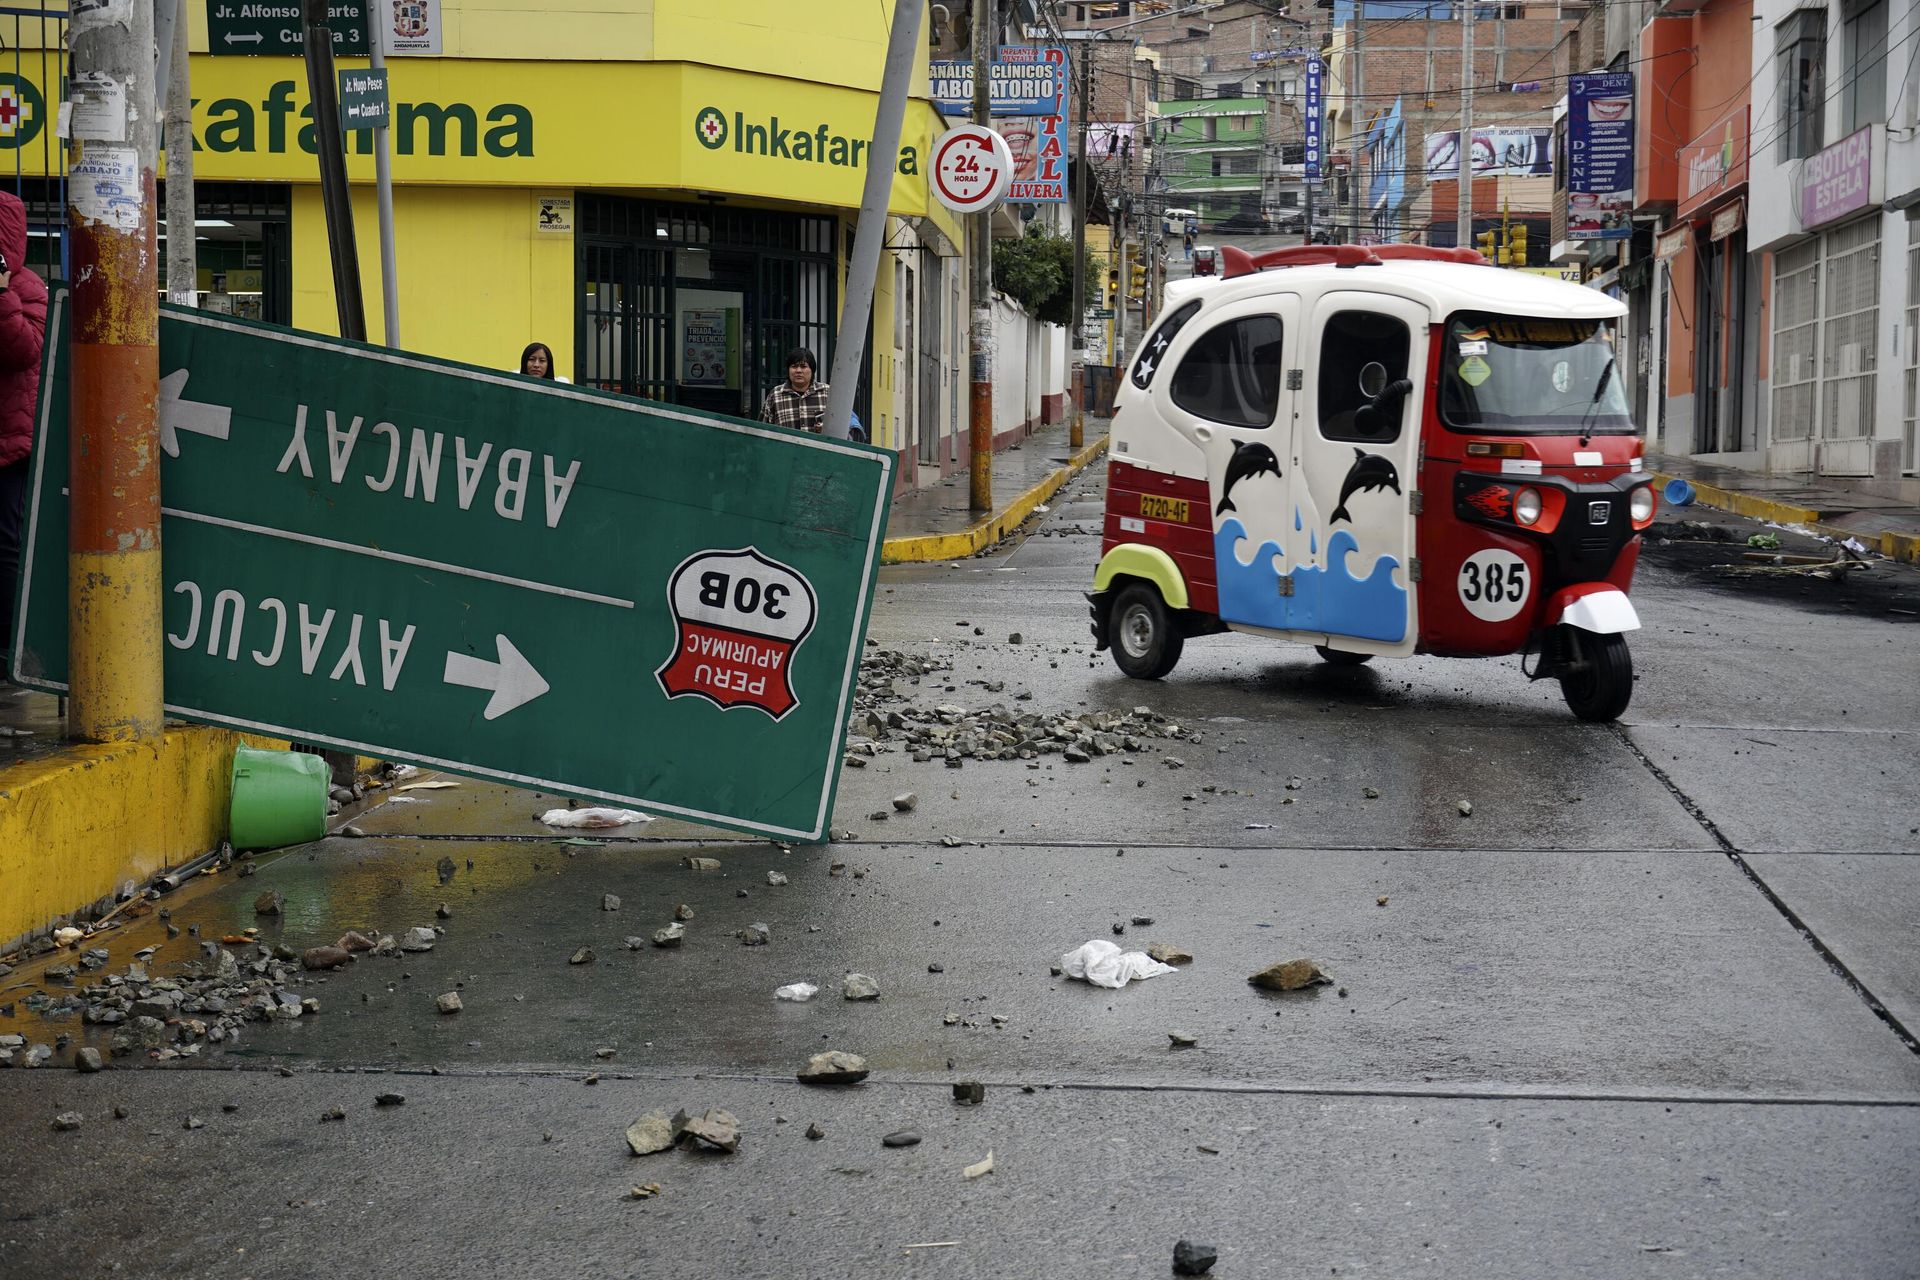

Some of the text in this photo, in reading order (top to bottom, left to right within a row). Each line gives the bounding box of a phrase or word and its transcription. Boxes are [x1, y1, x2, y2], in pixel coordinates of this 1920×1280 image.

[215, 5, 359, 18] Jr. Alfonso arte
[349, 28, 360, 43] 3
[929, 62, 1053, 79] ANÁLIS CLÍNICOS
[345, 76, 383, 95] Jr. Hugo Pesce
[928, 79, 1054, 98] LABOATORIO
[361, 101, 385, 117] Cuadra 1
[734, 111, 918, 176] Inkafara
[954, 154, 980, 173] 24
[1813, 131, 1869, 184] BOTICA
[1006, 183, 1064, 199] ILVERA
[1815, 166, 1863, 210] ESTELA
[689, 327, 712, 335] TRIADA
[275, 404, 582, 529] ABANCAY
[1142, 496, 1187, 521] 2720-4F
[1462, 561, 1525, 603] 385
[698, 570, 791, 620] 30B
[167, 580, 417, 692] AYACUC
[687, 633, 784, 670] APURIMAC
[694, 664, 766, 696] PERU
